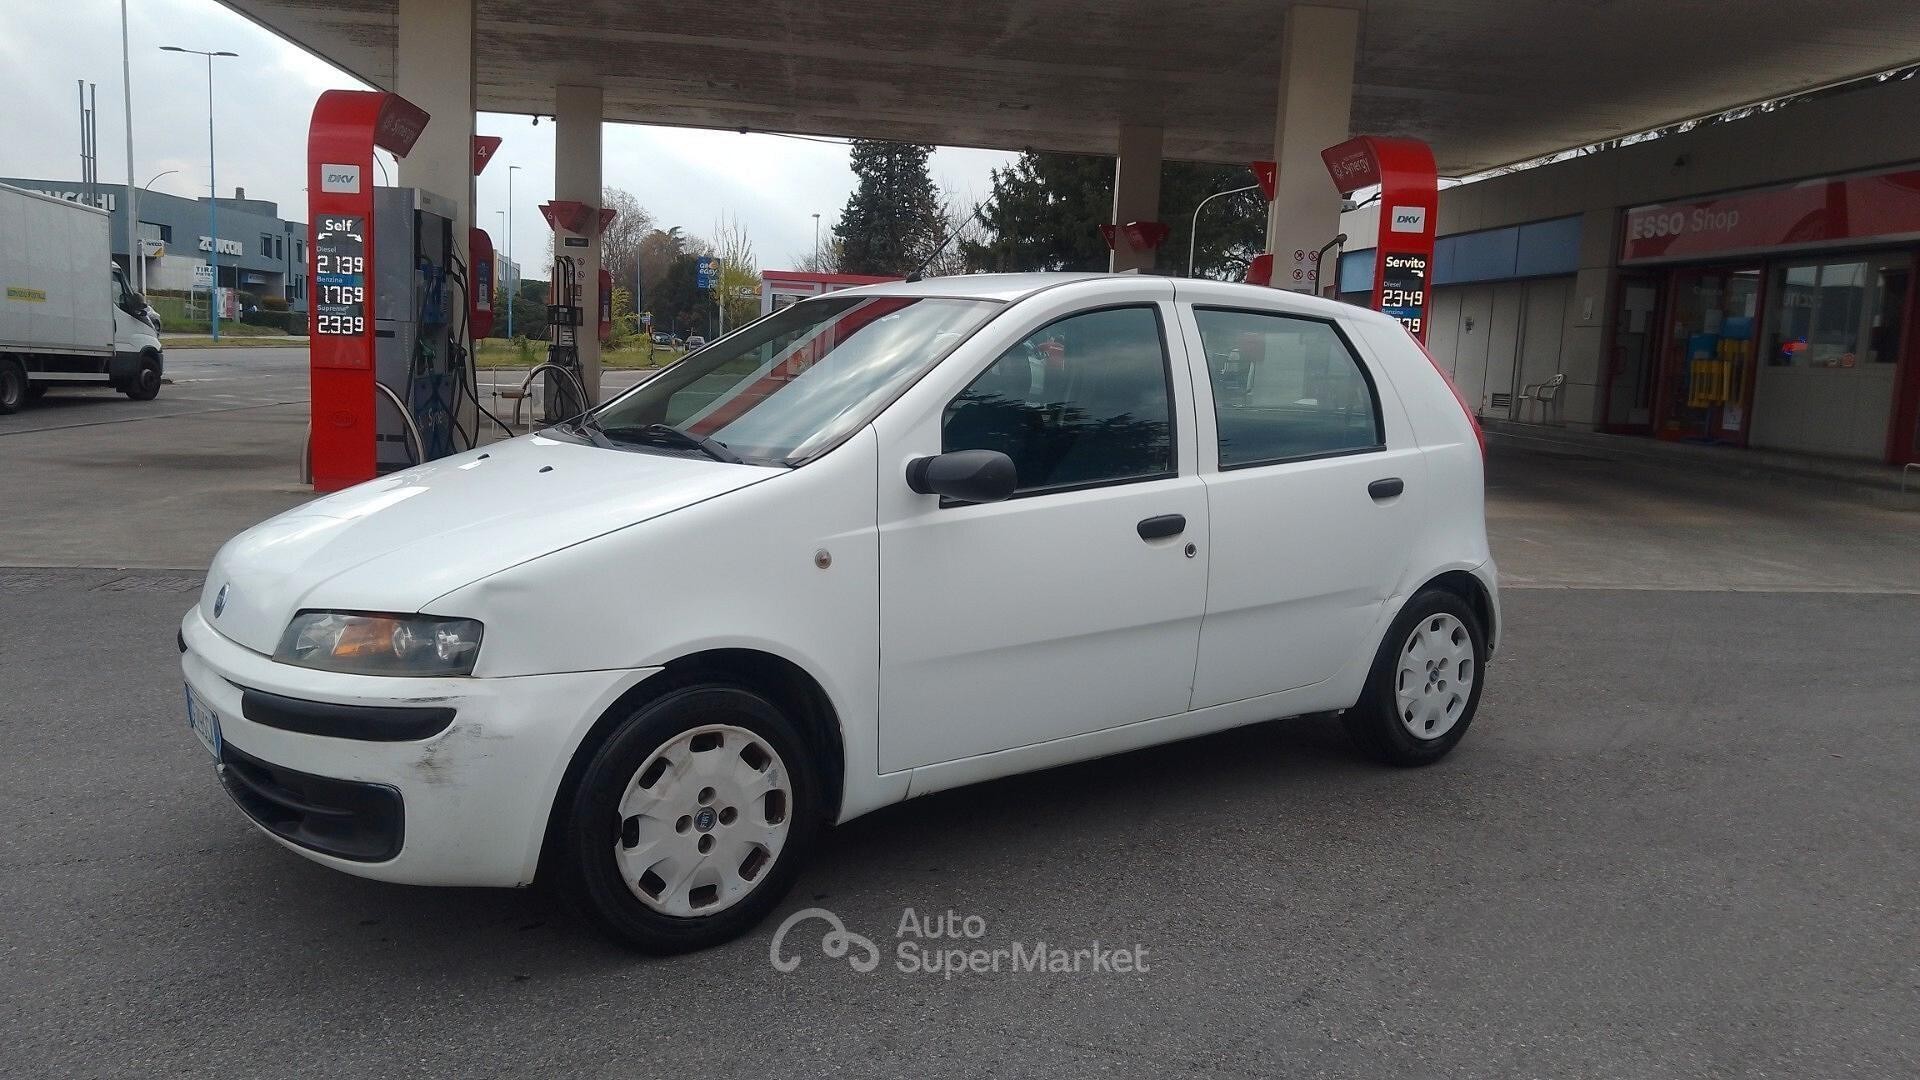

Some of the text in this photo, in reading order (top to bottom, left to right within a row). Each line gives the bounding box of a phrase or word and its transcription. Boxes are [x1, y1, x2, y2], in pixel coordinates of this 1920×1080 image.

[477, 146, 487, 157] 4
[1341, 157, 1371, 176] Synergy
[328, 174, 354, 183] DKV
[1266, 171, 1272, 183] 1
[547, 212, 553, 220] 6
[1397, 215, 1420, 224] DKV
[325, 219, 352, 231] Self
[1631, 207, 1738, 239] ESSO Shop
[1385, 256, 1425, 268] Servito
[699, 268, 717, 277] easy
